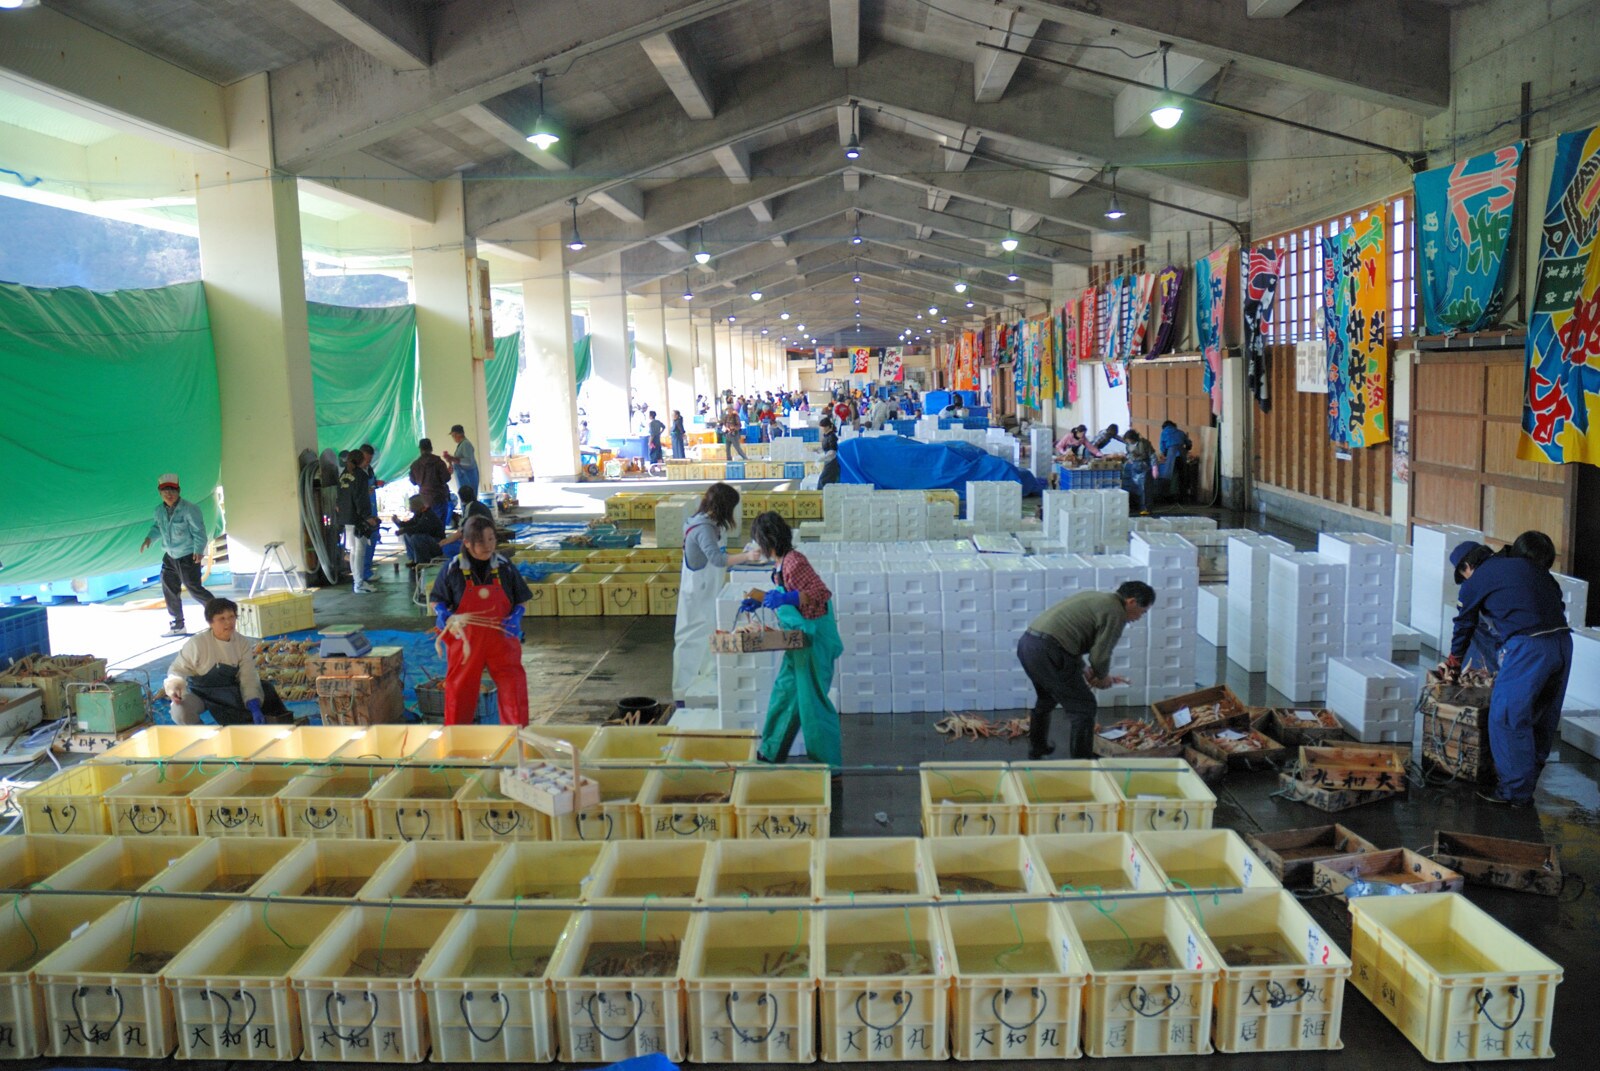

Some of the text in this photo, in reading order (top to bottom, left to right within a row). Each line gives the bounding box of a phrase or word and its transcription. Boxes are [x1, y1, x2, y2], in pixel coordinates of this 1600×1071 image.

[62, 1022, 147, 1048] 大和丸
[191, 1026, 276, 1049] 大和丸
[842, 1027, 931, 1053] 大和丸
[974, 1026, 1060, 1049] 大和丸
